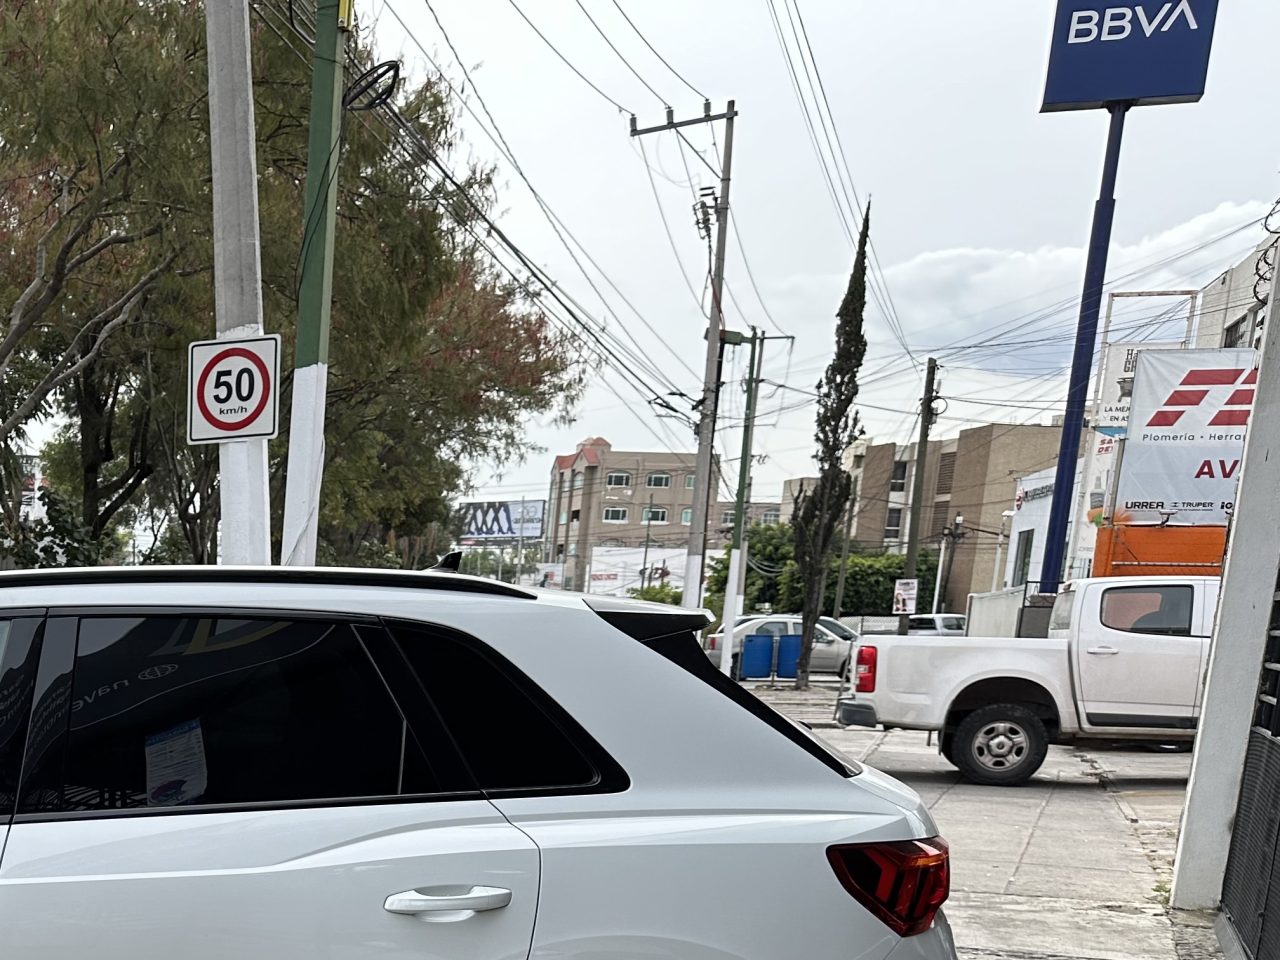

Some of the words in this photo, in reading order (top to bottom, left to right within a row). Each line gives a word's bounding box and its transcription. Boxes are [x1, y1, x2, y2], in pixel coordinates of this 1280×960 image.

[1067, 0, 1198, 44] BBVA
[213, 367, 255, 404] 50
[219, 406, 248, 415] km/h
[1142, 433, 1195, 442] Plomería
[1125, 501, 1164, 509] URREA
